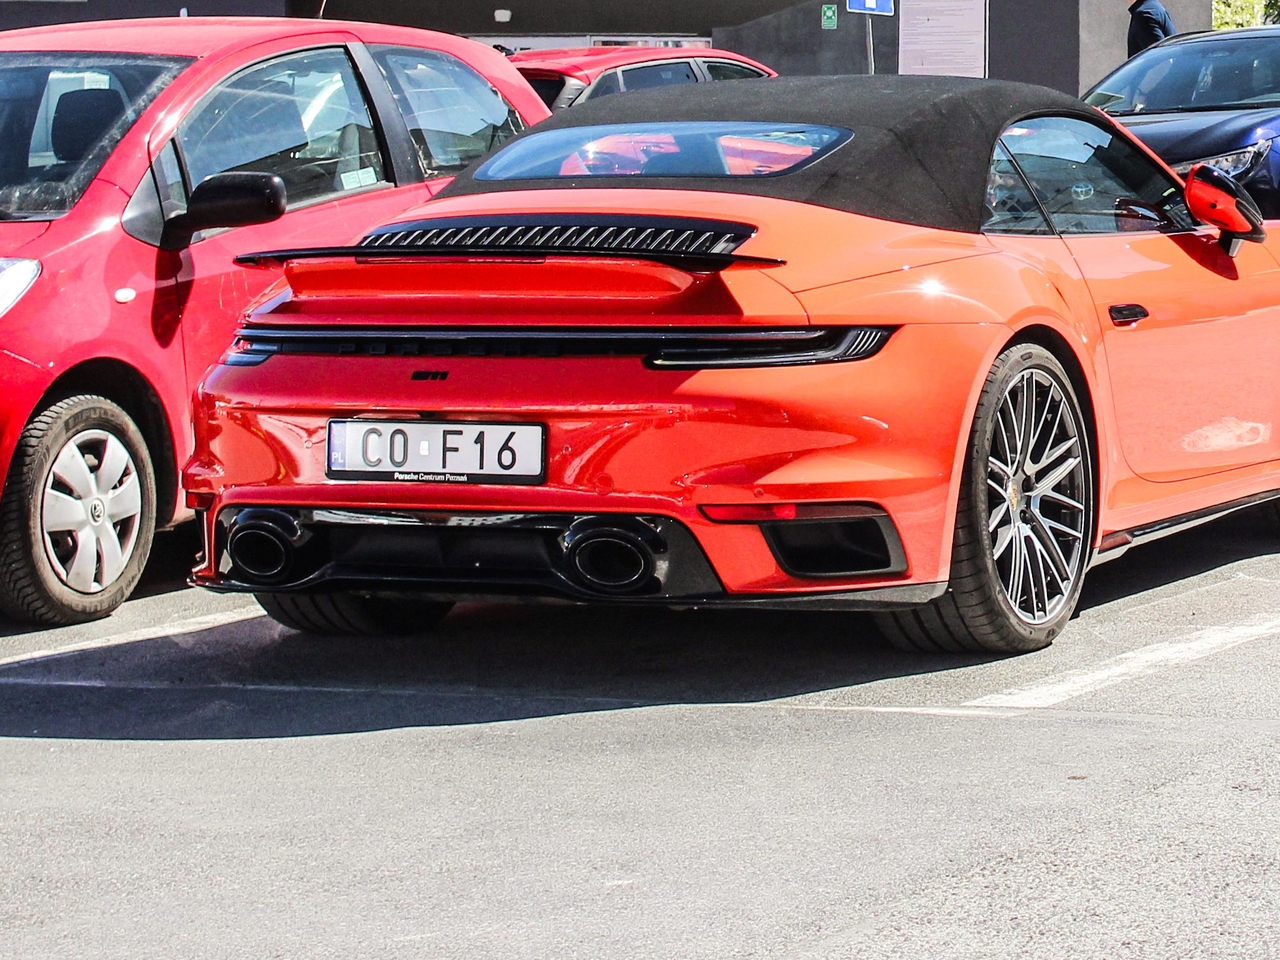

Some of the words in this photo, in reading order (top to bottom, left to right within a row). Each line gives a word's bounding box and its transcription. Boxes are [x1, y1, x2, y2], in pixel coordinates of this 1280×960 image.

[441, 429, 517, 471] F16
[331, 452, 344, 463] PL
[394, 472, 418, 481] Porsche
[419, 473, 445, 481] Centrum
[445, 474, 468, 482] Poznań
